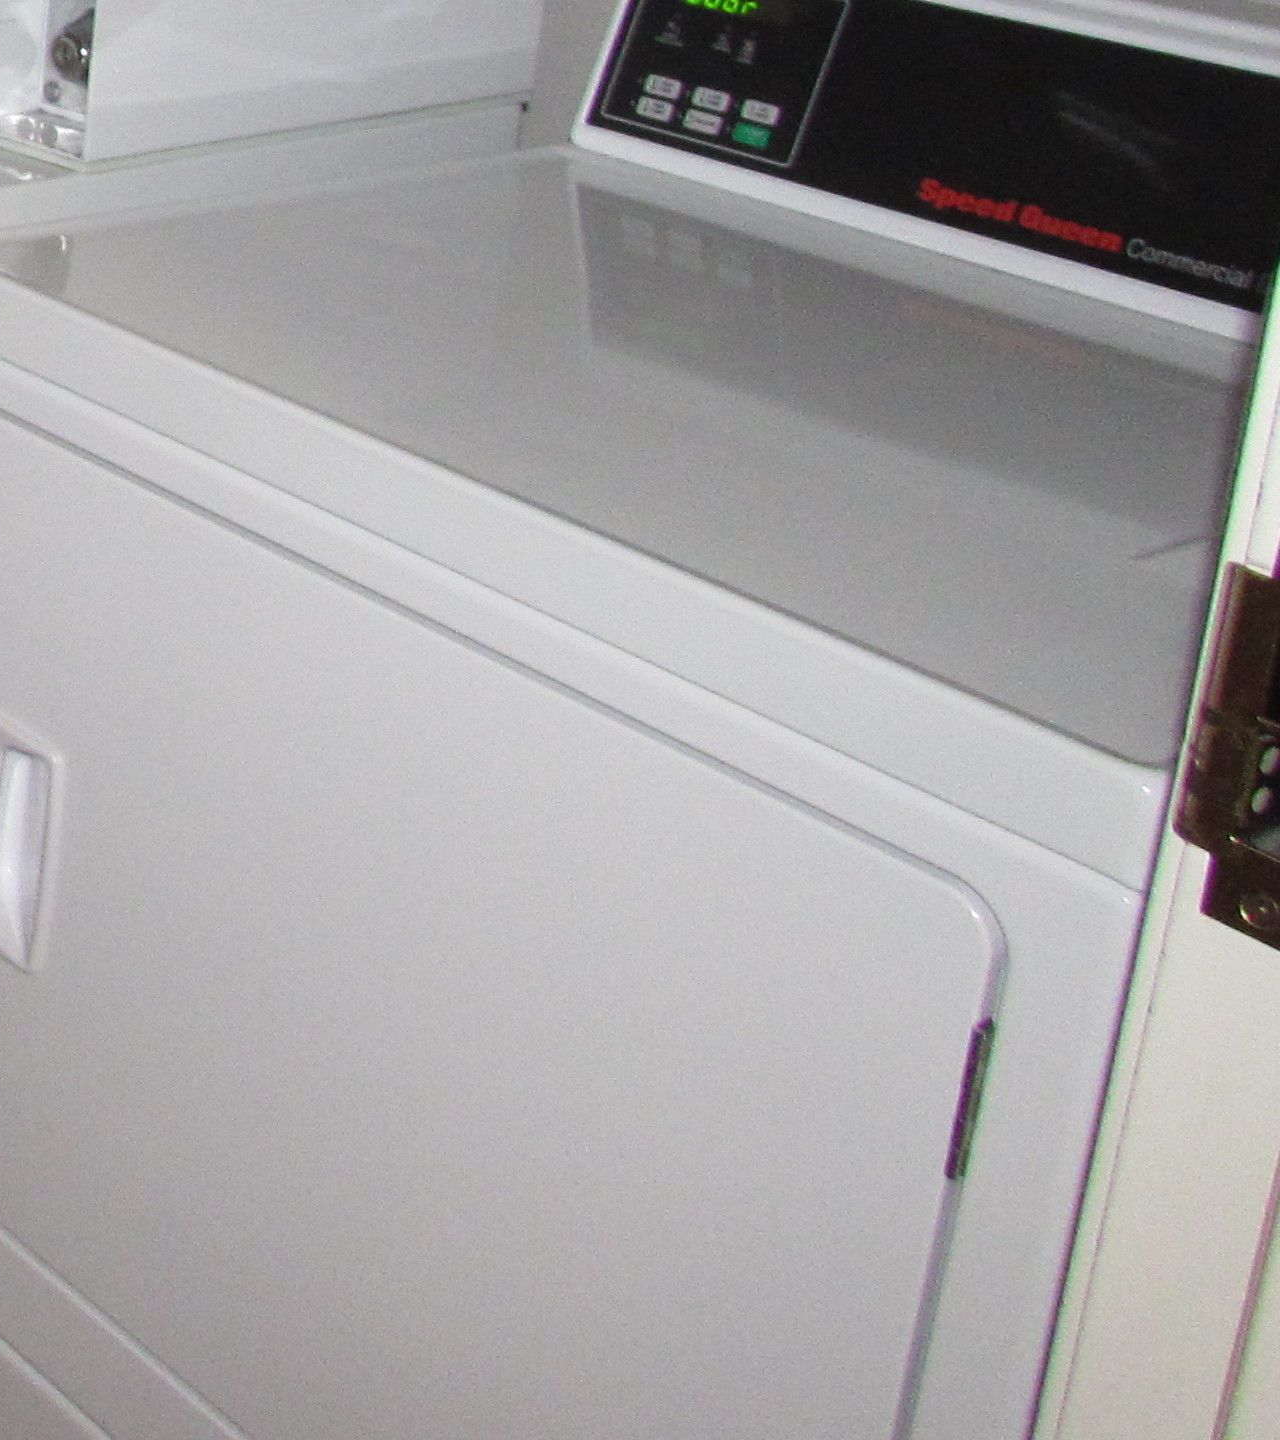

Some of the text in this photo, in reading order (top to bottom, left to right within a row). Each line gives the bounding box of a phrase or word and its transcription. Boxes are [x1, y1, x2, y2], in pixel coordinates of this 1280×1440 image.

[917, 178, 1255, 289] Speed Queen Commercial
